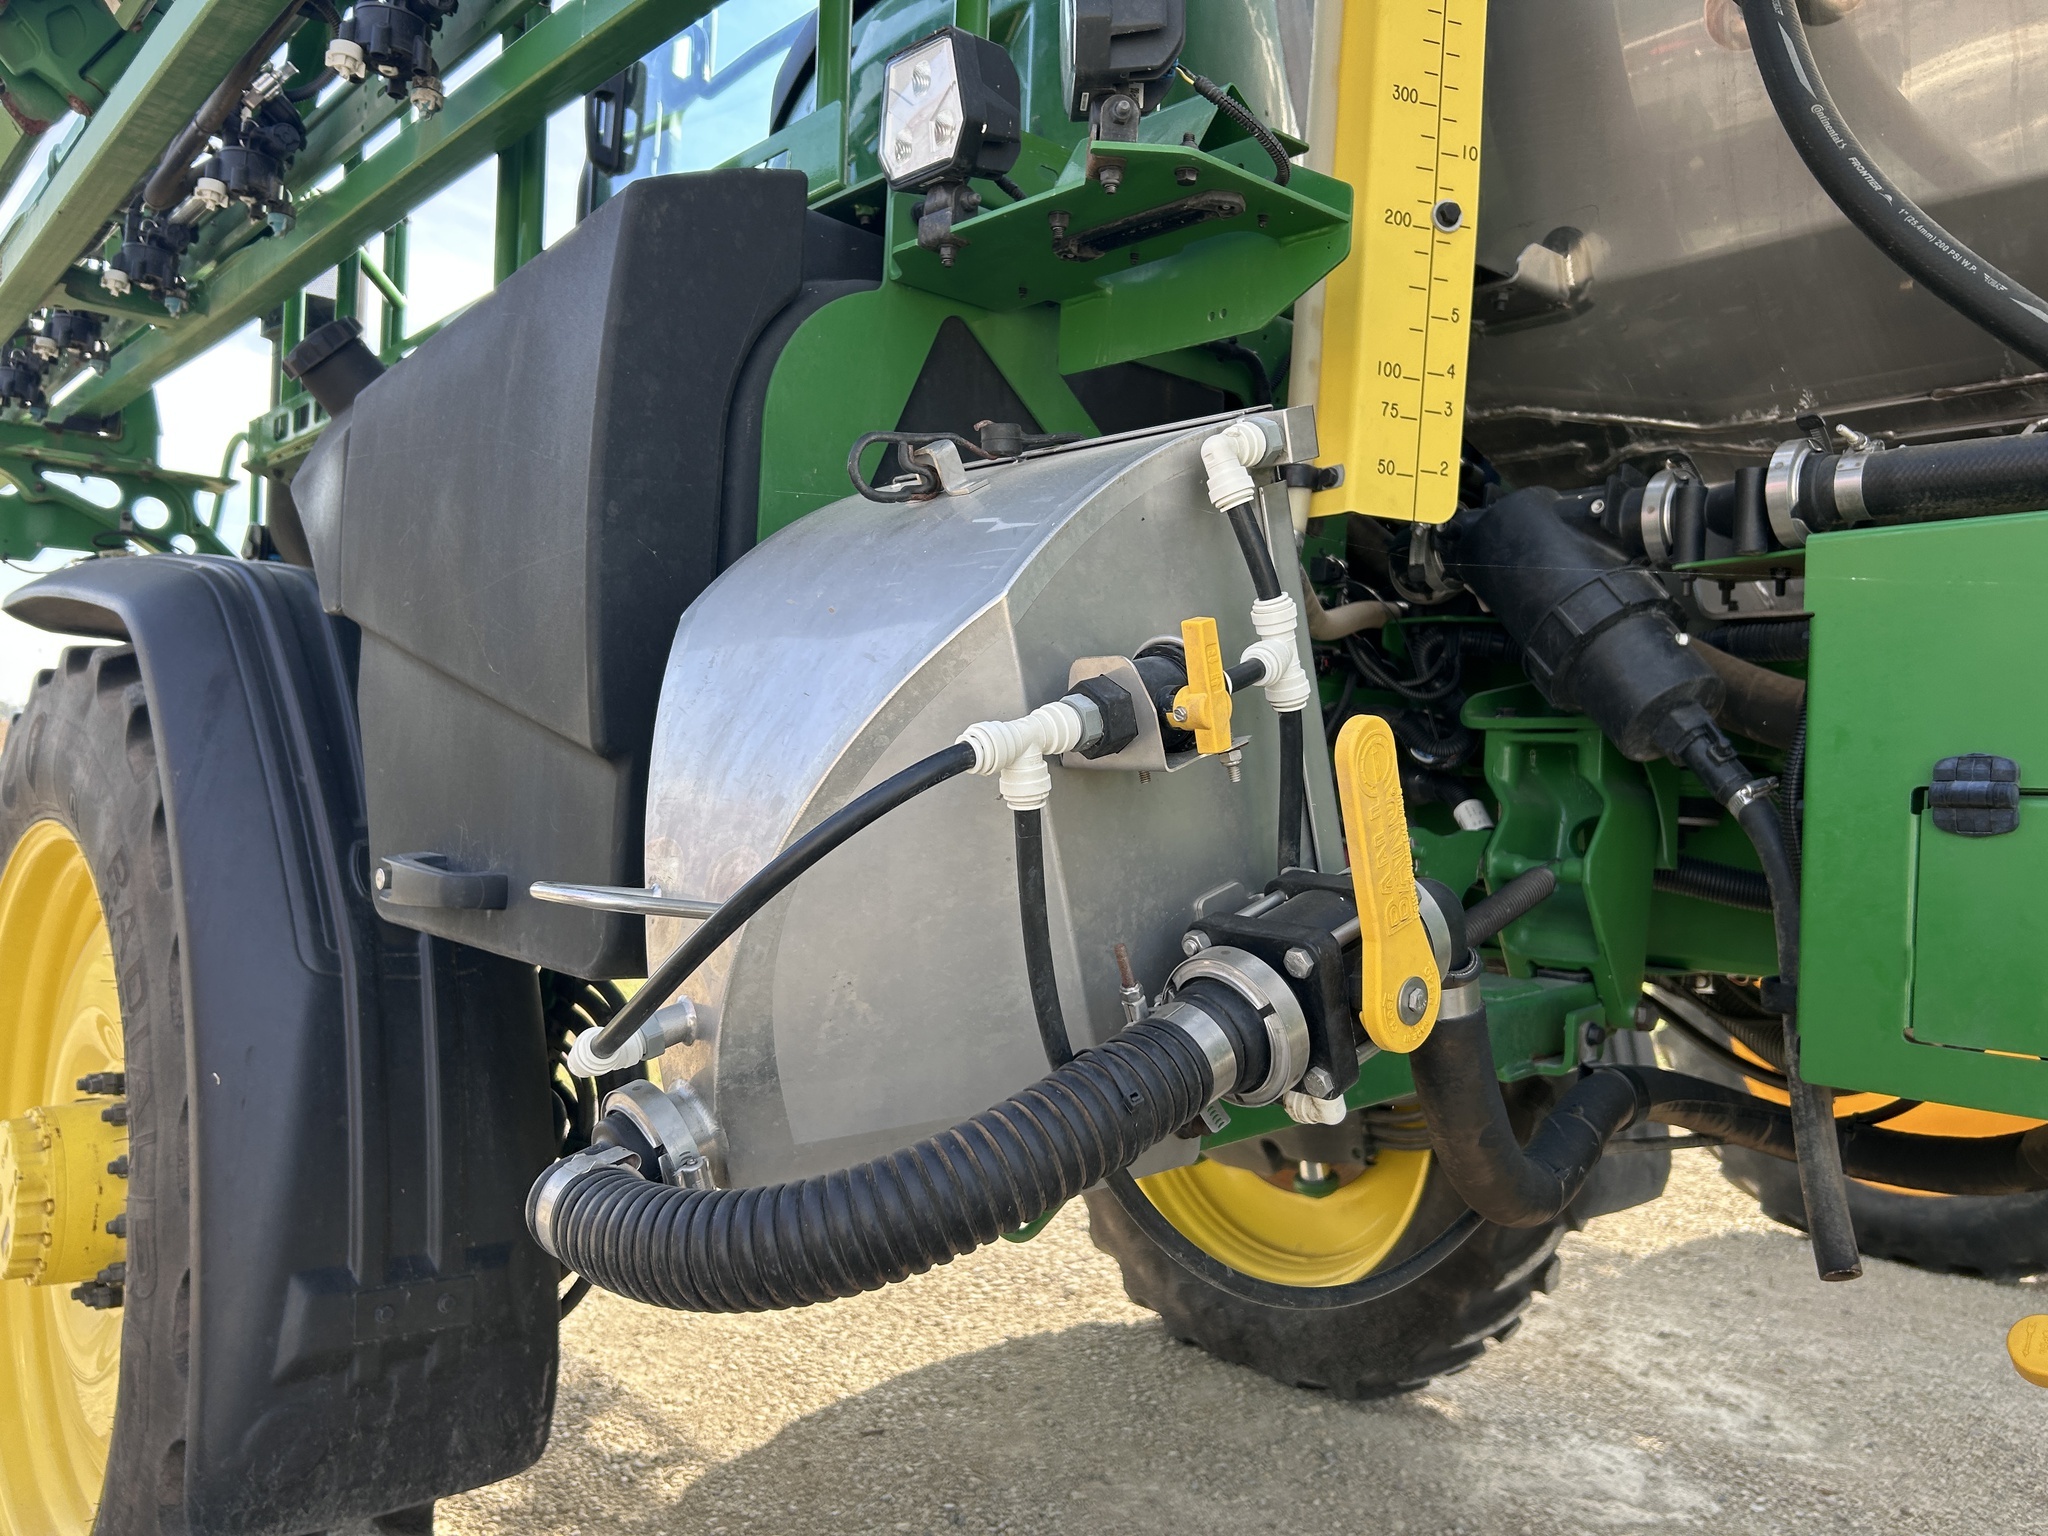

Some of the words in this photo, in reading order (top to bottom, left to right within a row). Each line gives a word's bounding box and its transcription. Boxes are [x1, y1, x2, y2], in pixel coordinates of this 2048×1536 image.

[1392, 85, 1418, 104] 300
[1461, 145, 1479, 162] 10
[1810, 104, 1844, 150] Continental
[1848, 156, 1883, 192] FRONTIER
[1903, 214, 1937, 243] (25.4mm)
[1934, 239, 1950, 252] 200
[1947, 249, 1963, 262] PSI
[1961, 258, 1978, 275] W.P.
[1384, 208, 1412, 228] 200
[1450, 308, 1460, 324] 5
[1376, 360, 1401, 379] 100
[1446, 363, 1456, 380] 4
[1380, 402, 1399, 418] 75
[1443, 401, 1453, 418] 3
[1377, 461, 1395, 477] 50
[1440, 461, 1449, 478] 2
[1386, 993, 1399, 1032] CLOSE
